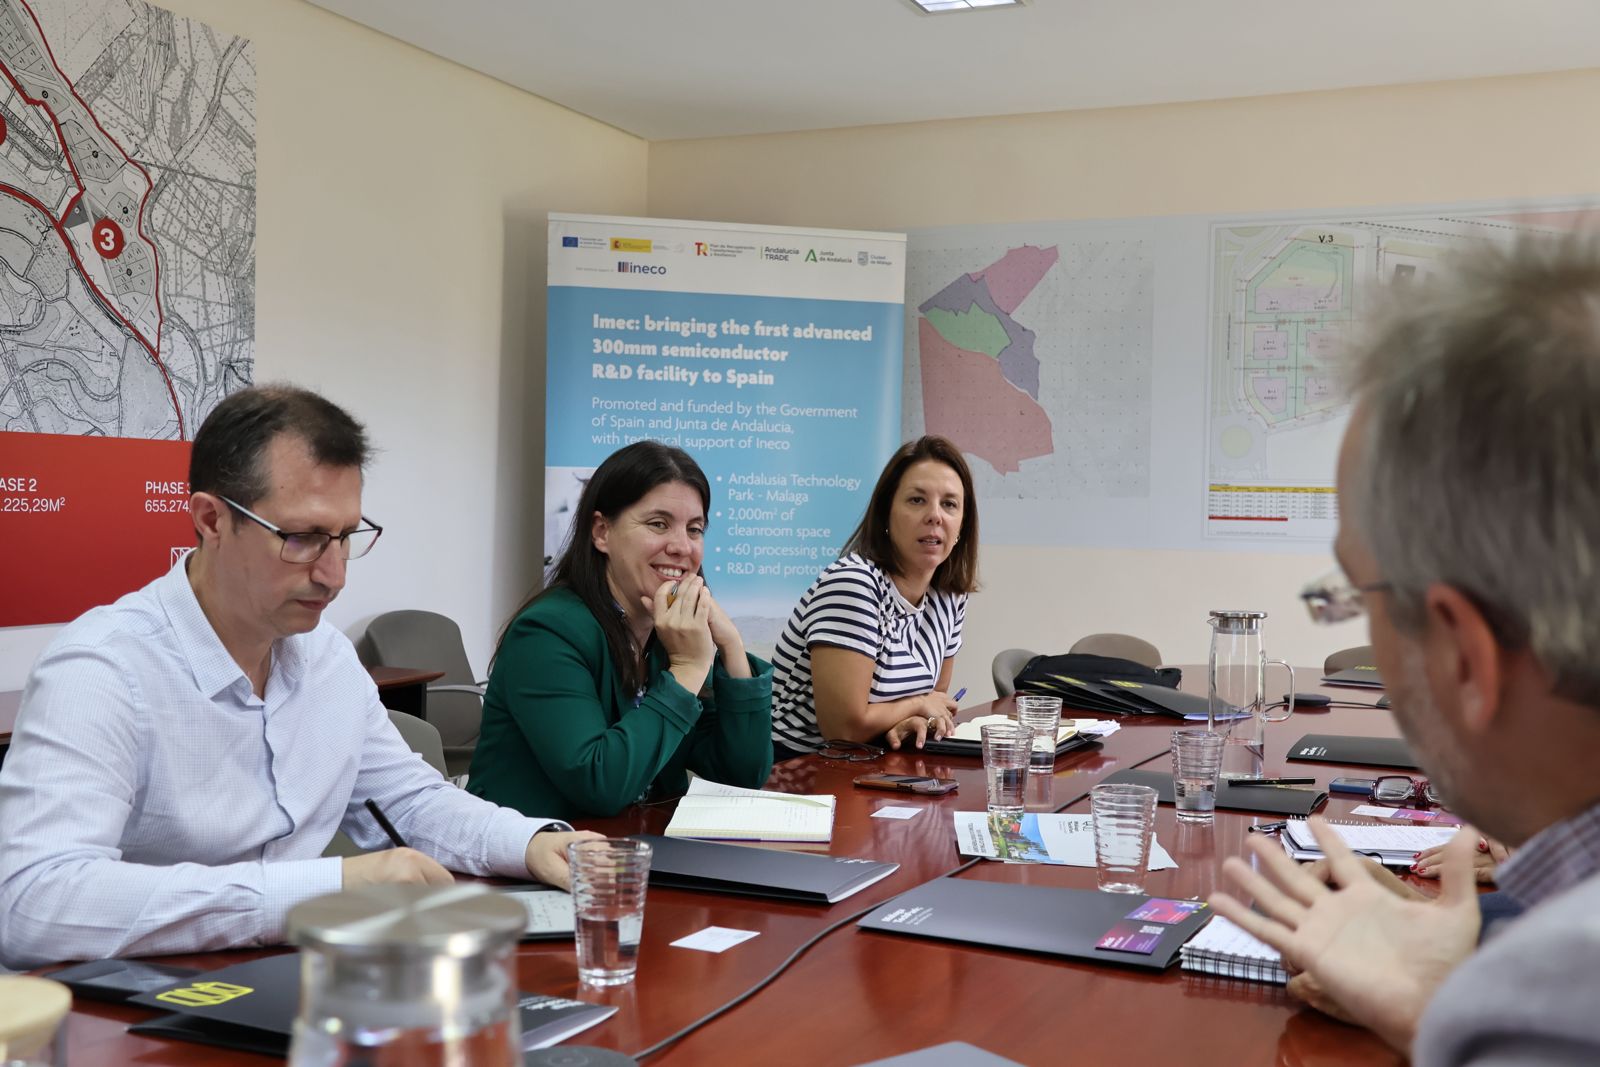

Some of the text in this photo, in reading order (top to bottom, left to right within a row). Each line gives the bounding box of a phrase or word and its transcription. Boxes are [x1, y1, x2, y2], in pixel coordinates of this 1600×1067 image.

[100, 228, 115, 251] 3
[1318, 235, 1334, 243] V.3
[764, 253, 789, 261] TRADE
[629, 261, 667, 275] ineco
[593, 313, 873, 341] Imec: bringing the first advanced
[592, 338, 789, 361] 300mm semiconductor
[592, 363, 775, 389] R&D facility to Spain
[592, 396, 858, 418] Promoted and funded by the Government
[591, 413, 607, 427] of
[610, 415, 645, 431] Spain
[648, 416, 672, 429] and
[674, 418, 708, 431] Junta
[711, 418, 728, 431] de
[591, 432, 620, 445] with
[685, 437, 735, 450] support
[738, 436, 753, 449] of
[756, 437, 791, 450] Ineco
[29, 478, 38, 492] 2
[145, 481, 185, 495] PHASE
[728, 473, 862, 490] Andalusia Technology
[728, 488, 754, 501] Park
[781, 507, 796, 520] of
[727, 523, 831, 540] cleanroom space
[728, 543, 750, 556] +60
[754, 545, 818, 559] processing
[727, 562, 754, 574] R&D
[758, 562, 781, 575] and
